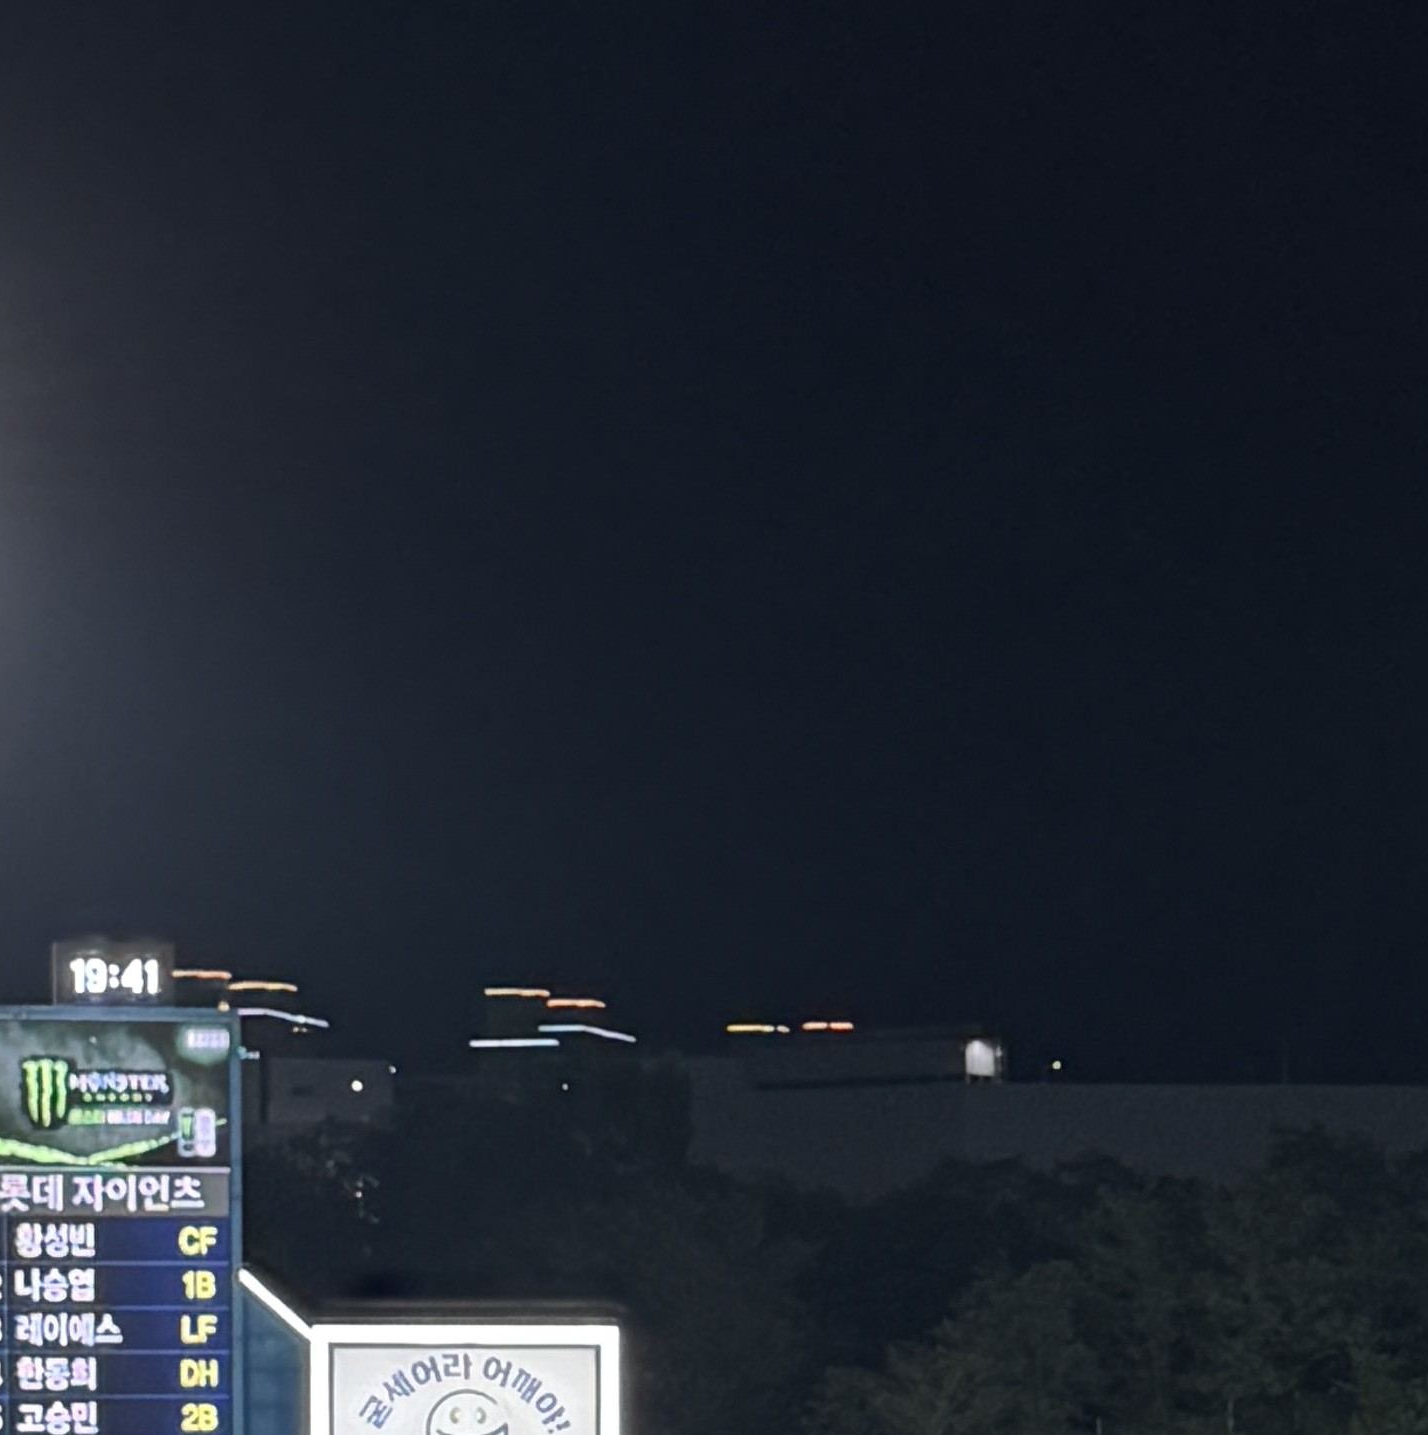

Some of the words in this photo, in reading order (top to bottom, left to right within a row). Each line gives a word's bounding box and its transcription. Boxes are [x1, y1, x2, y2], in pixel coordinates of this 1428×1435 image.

[70, 958, 159, 994] 19:41
[72, 1173, 205, 1213] 자이언츠
[178, 1226, 218, 1255] CF
[182, 1270, 216, 1299] 1B
[180, 1314, 218, 1344] LF
[179, 1358, 219, 1388] DH
[180, 1402, 219, 1432] 2B
